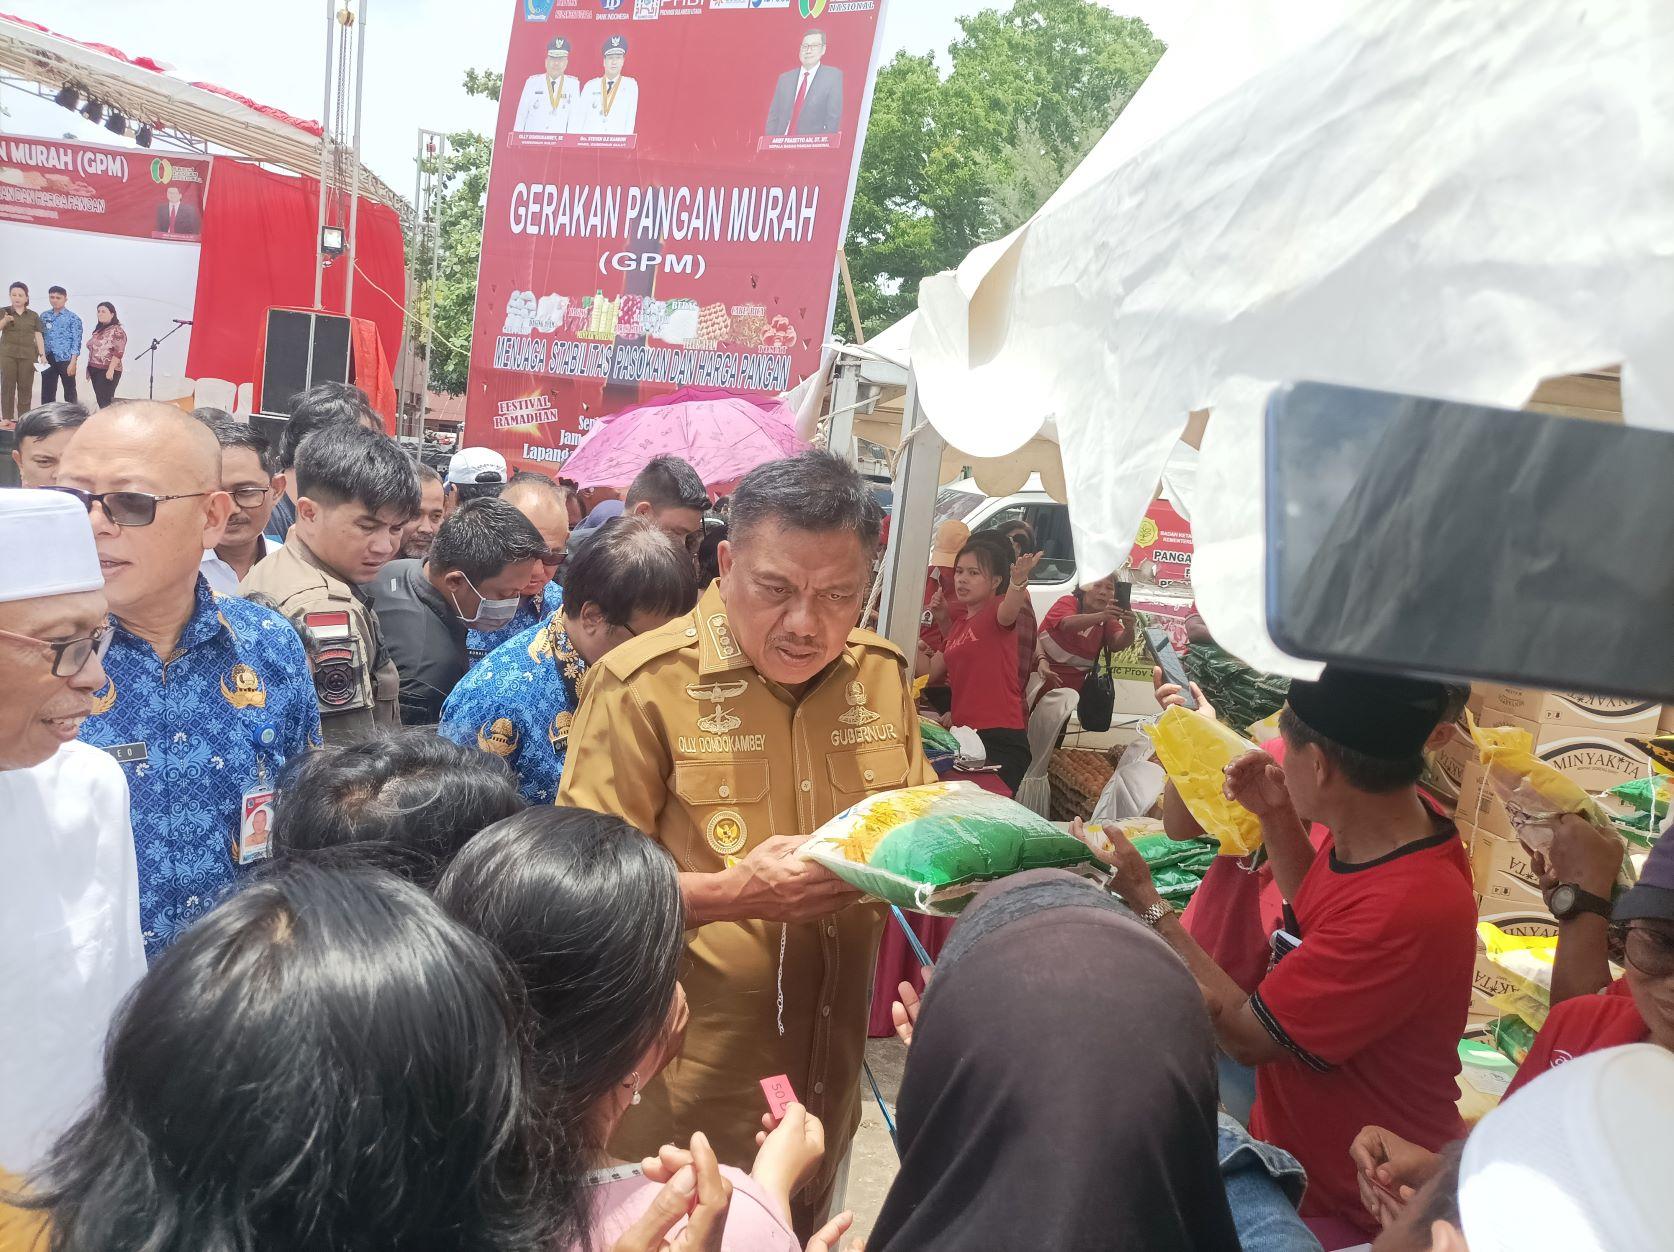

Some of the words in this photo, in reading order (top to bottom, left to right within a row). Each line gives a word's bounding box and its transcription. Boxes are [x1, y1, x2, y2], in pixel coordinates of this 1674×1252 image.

[10, 141, 74, 171] MURAH
[77, 150, 129, 183] (GPM)
[67, 194, 106, 214] PANGAN
[509, 182, 622, 238] GERAKAN
[623, 185, 725, 242] PANGAN
[727, 185, 820, 243] MURAH
[598, 251, 707, 279] (GPM)
[493, 336, 547, 372] MENJAGA
[548, 340, 613, 378] STABILITAS
[613, 345, 671, 383] PASOKAN
[669, 349, 698, 386] DAN
[695, 350, 738, 388] HARGA
[737, 353, 792, 391] PANGAN
[498, 396, 551, 413] FESTIVAL
[494, 409, 558, 429] RAMADHAN
[678, 736, 697, 753] OLLY
[699, 734, 767, 753] DONDOKAMBEY
[830, 723, 898, 747] GUBERNUR
[1553, 752, 1640, 779] MINYAKITA
